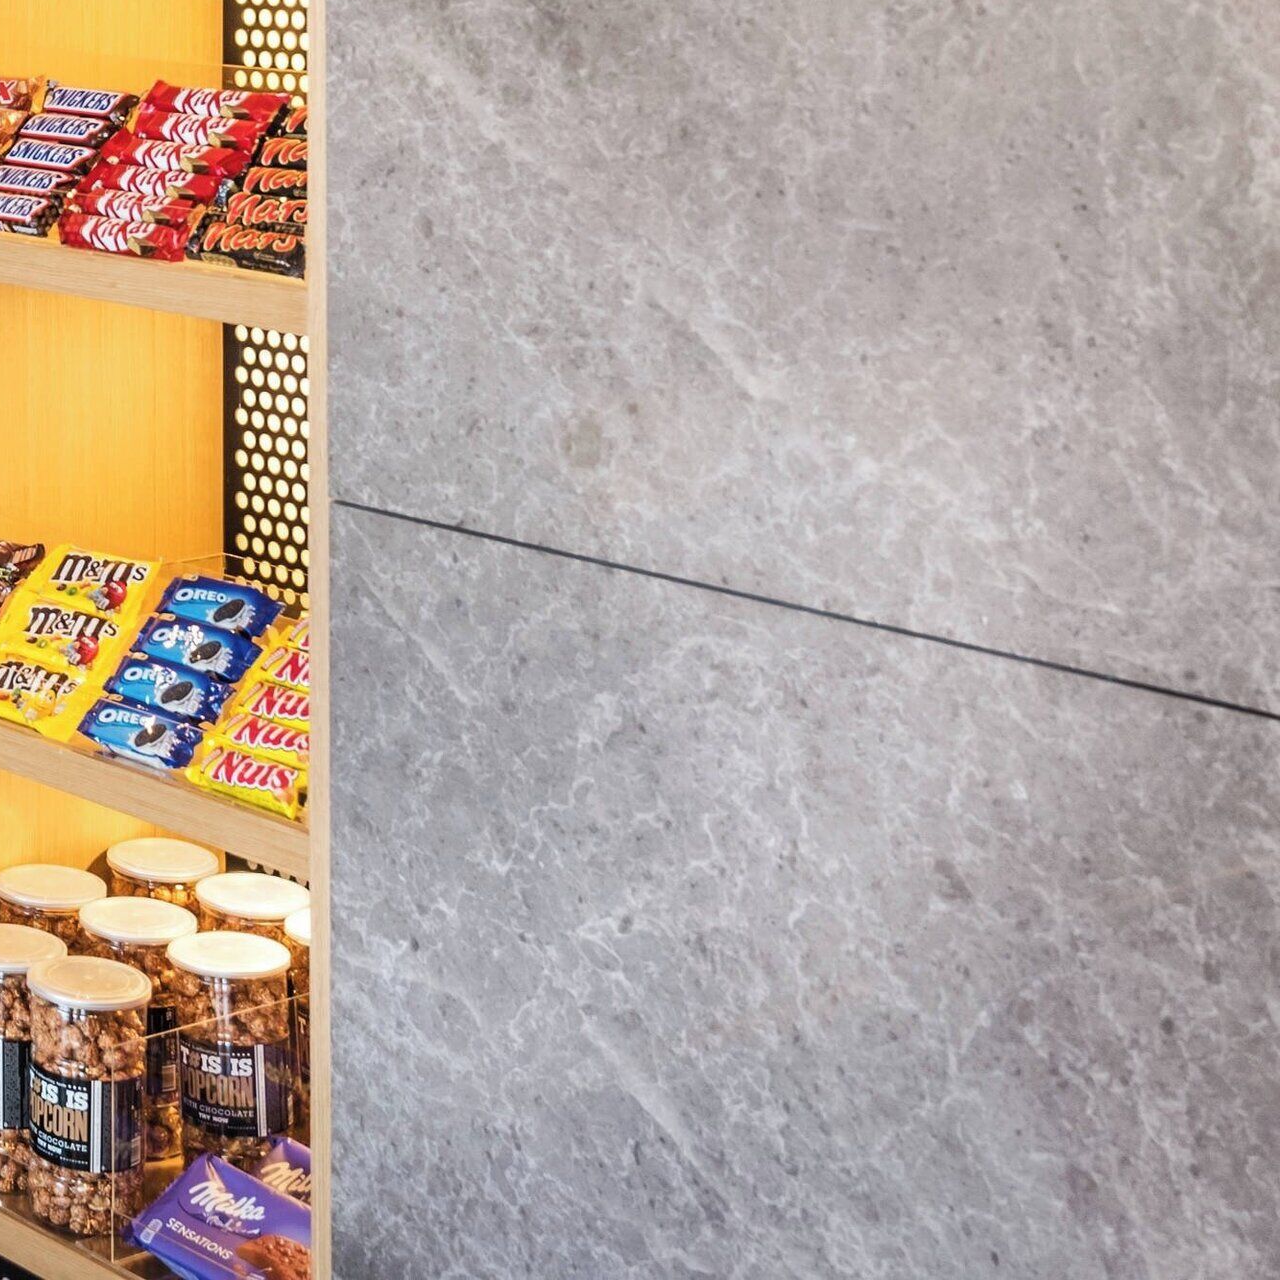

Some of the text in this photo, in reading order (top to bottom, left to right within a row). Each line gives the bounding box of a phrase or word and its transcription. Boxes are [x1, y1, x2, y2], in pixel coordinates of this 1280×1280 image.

[51, 88, 116, 111] SNICKERS
[23, 115, 93, 136] SNICKERS
[10, 140, 80, 165] SNICKERS
[203, 222, 297, 253] Mars
[175, 588, 226, 602] OREO
[230, 1057, 253, 1076] IS
[66, 1089, 89, 1111] IS
[199, 1104, 254, 1118] CHOCOLATE
[38, 1130, 88, 1152] CHOCOLATE
[188, 1180, 266, 1221] Milka
[165, 1217, 234, 1260] SENSATIONS
